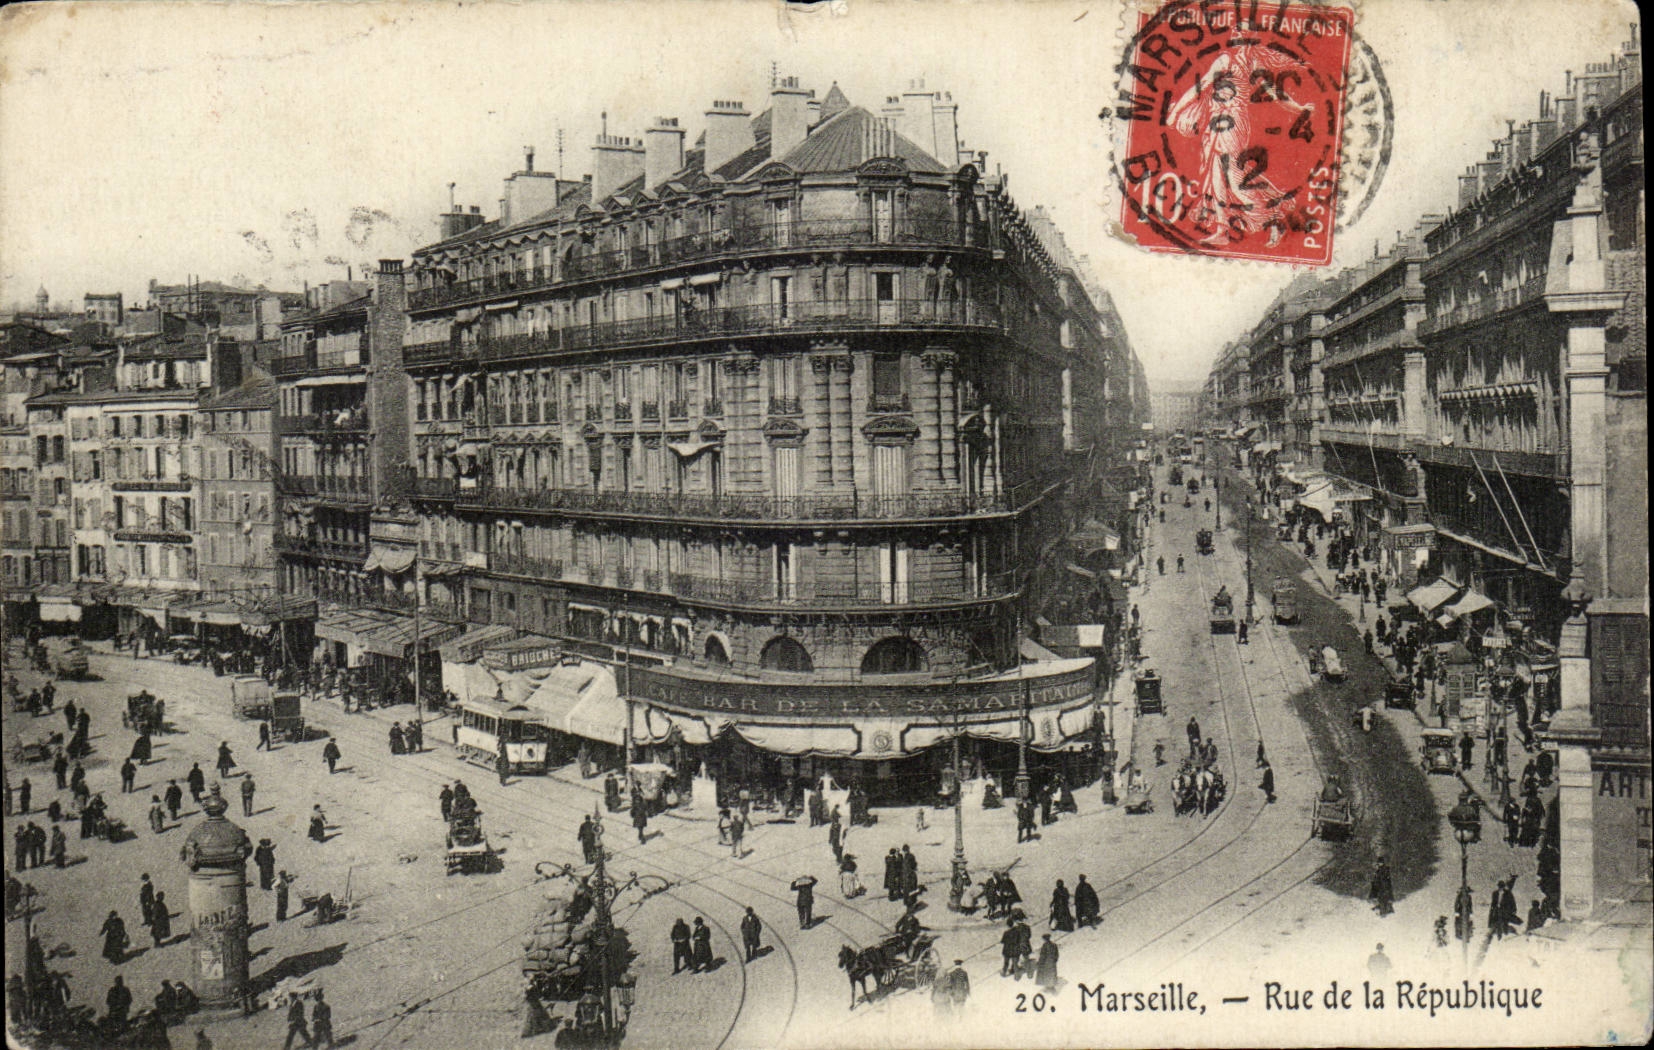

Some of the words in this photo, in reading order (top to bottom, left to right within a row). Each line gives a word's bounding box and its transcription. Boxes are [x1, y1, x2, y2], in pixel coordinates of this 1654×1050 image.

[1149, 7, 1235, 27] PUBLIQUE
[1261, 14, 1343, 37] FRANÇAISE
[1303, 167, 1329, 249] POSTES
[703, 695, 759, 711] BAR
[776, 698, 820, 713] DE
[841, 698, 890, 713] LA
